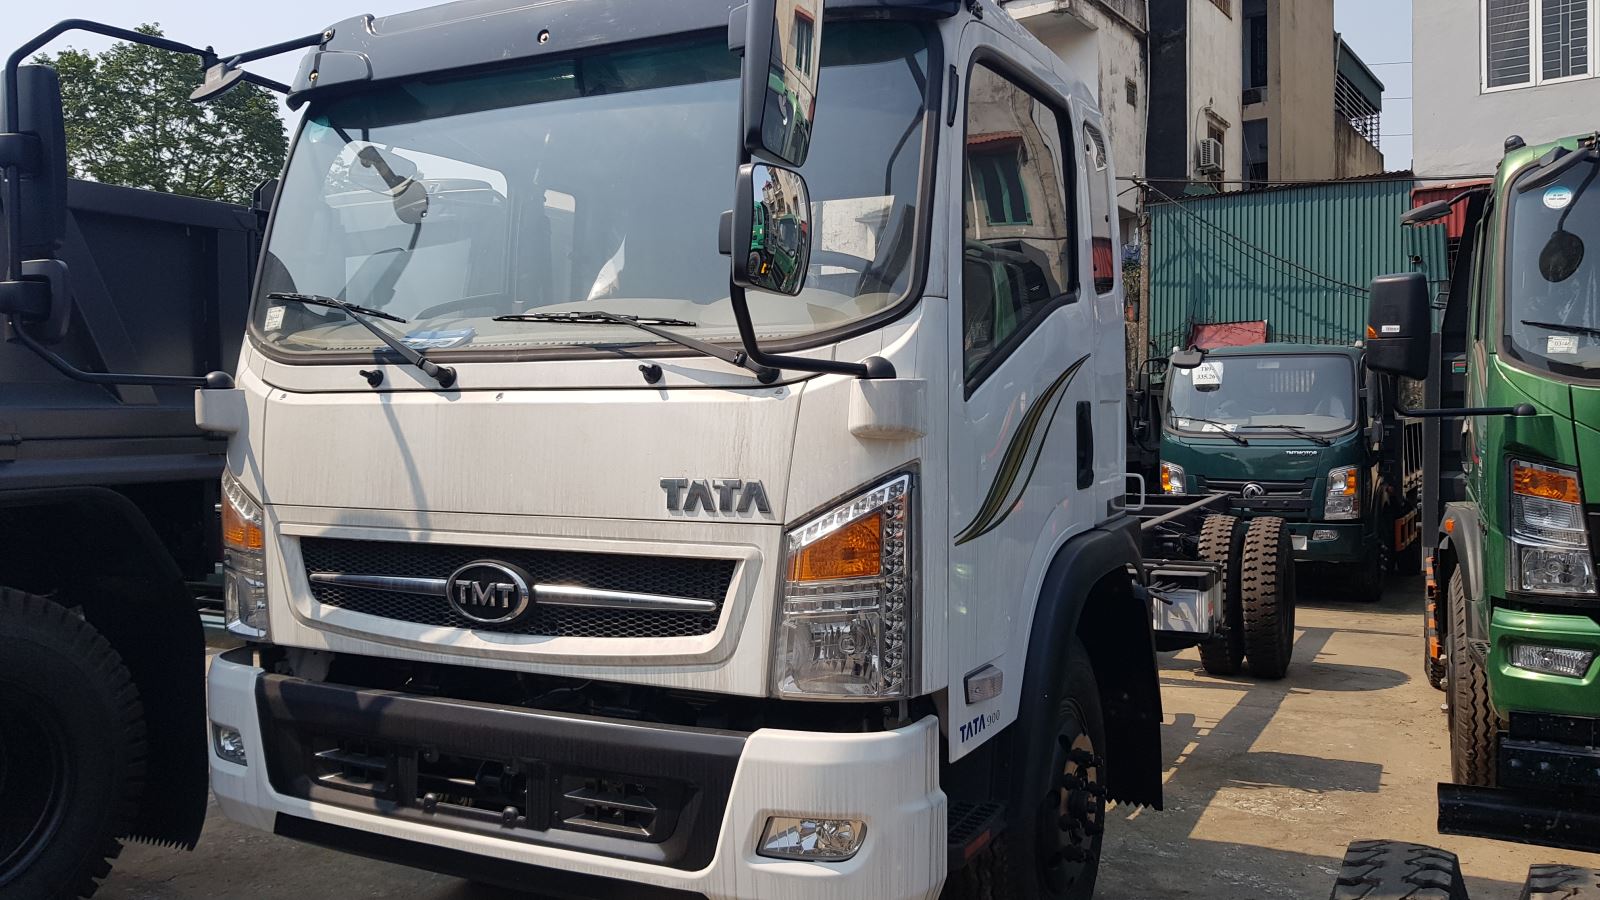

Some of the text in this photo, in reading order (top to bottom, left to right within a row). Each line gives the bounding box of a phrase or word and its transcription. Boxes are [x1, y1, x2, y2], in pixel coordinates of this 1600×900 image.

[660, 477, 772, 514] TATA
[455, 579, 515, 608] TMT
[959, 709, 1001, 743] TATA 900
